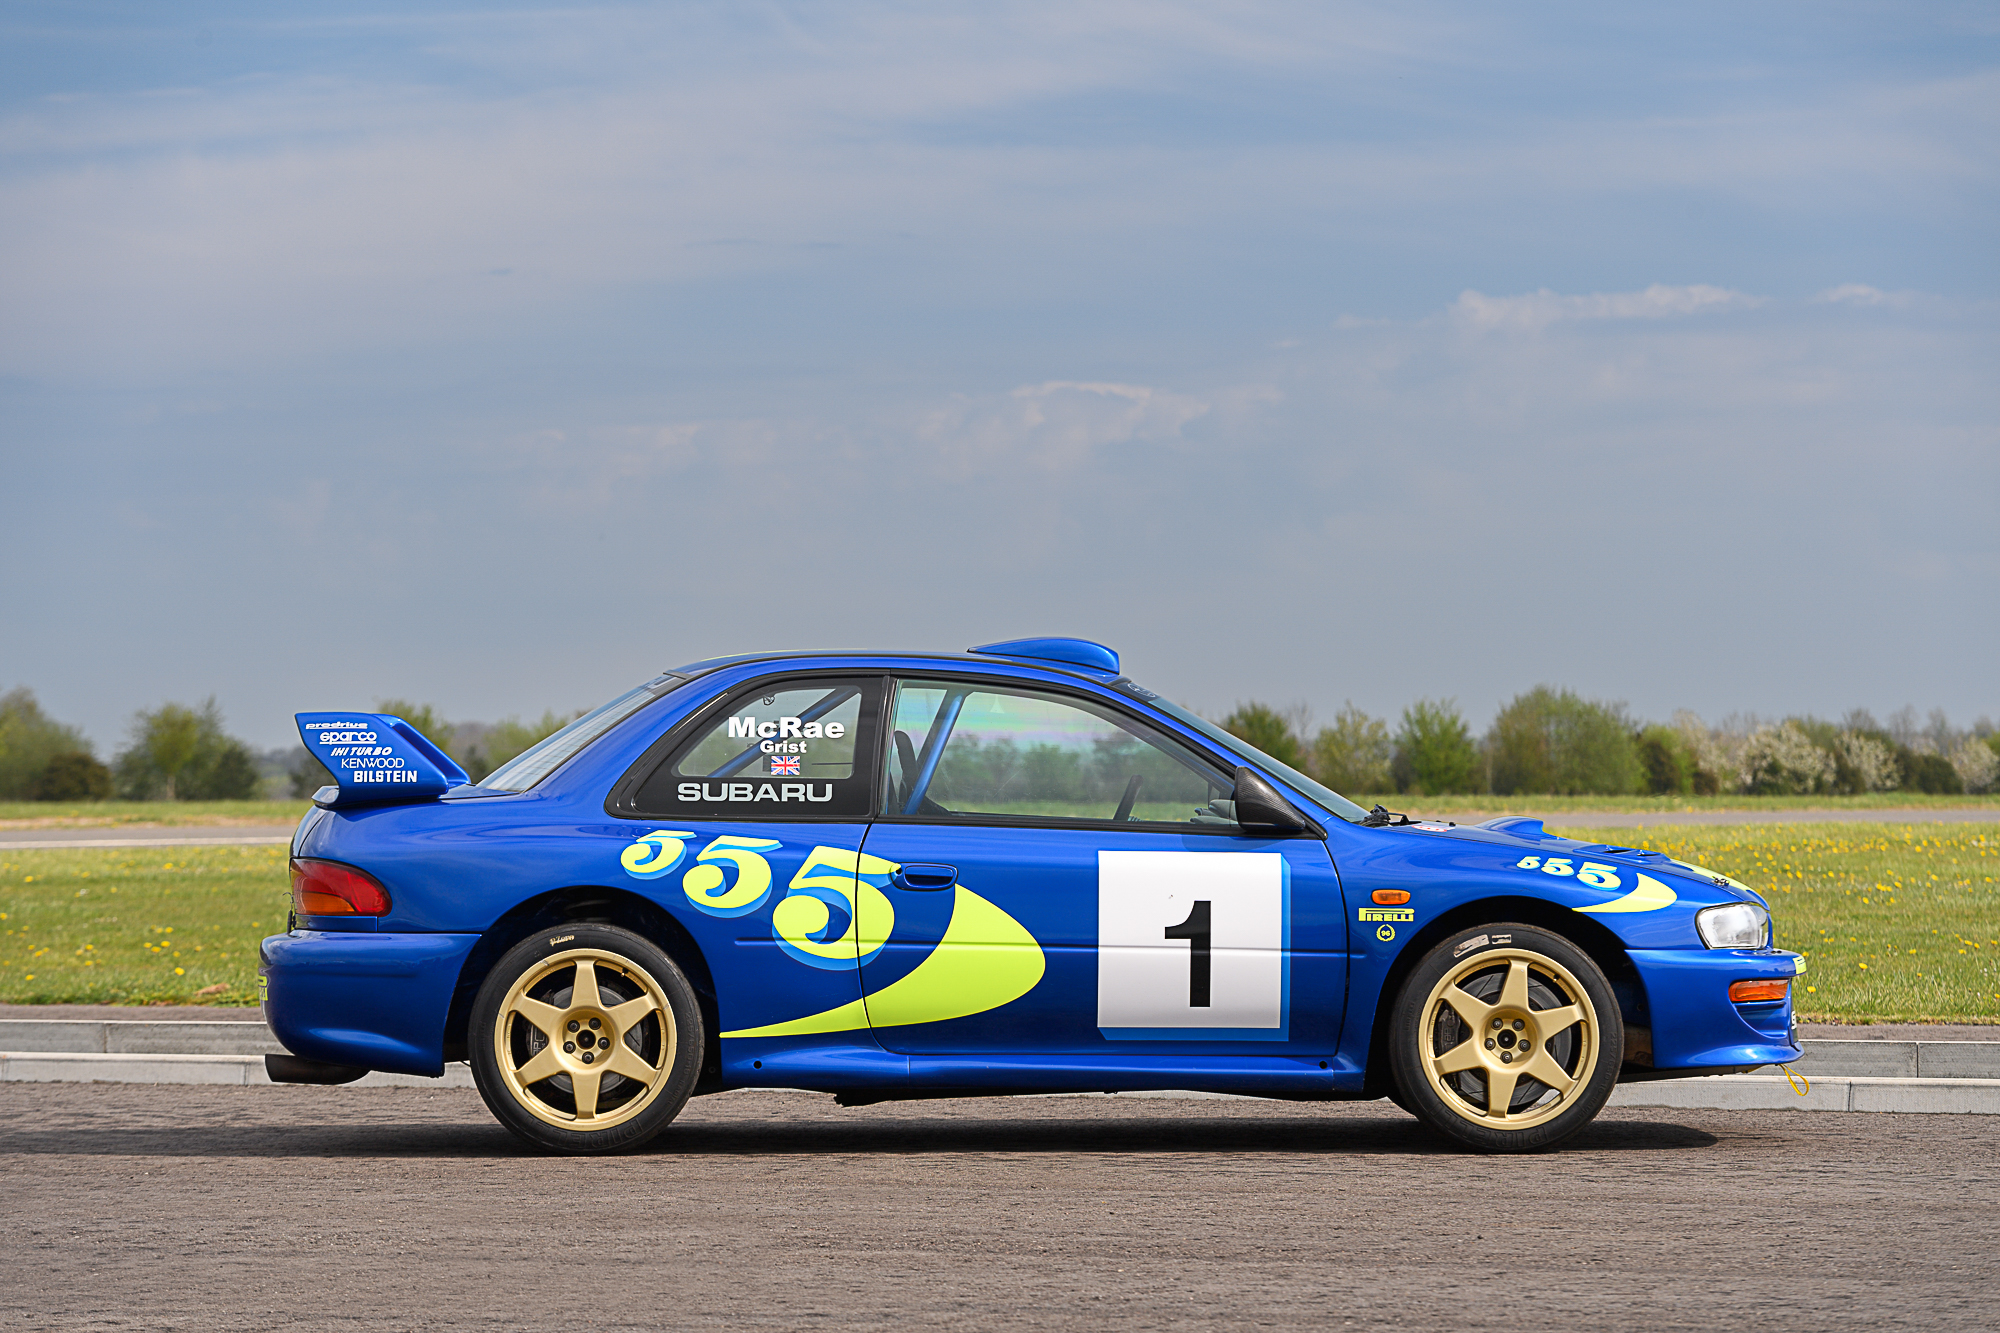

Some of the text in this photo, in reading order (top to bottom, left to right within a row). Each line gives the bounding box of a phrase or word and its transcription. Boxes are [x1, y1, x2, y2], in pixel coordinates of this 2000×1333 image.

[727, 716, 846, 740] McRae
[319, 731, 378, 745] sparco
[330, 746, 393, 757] IHI TURBO
[759, 740, 807, 754] Grist
[341, 757, 405, 769] KENWOOD
[353, 770, 418, 783] BILSTEIN
[677, 782, 833, 802] SUBARU
[1358, 907, 1415, 922] PIRELLI
[1164, 900, 1212, 1008] 1
[521, 1114, 645, 1150] PIRELLI
[1428, 1102, 1549, 1148] PIRELLI
